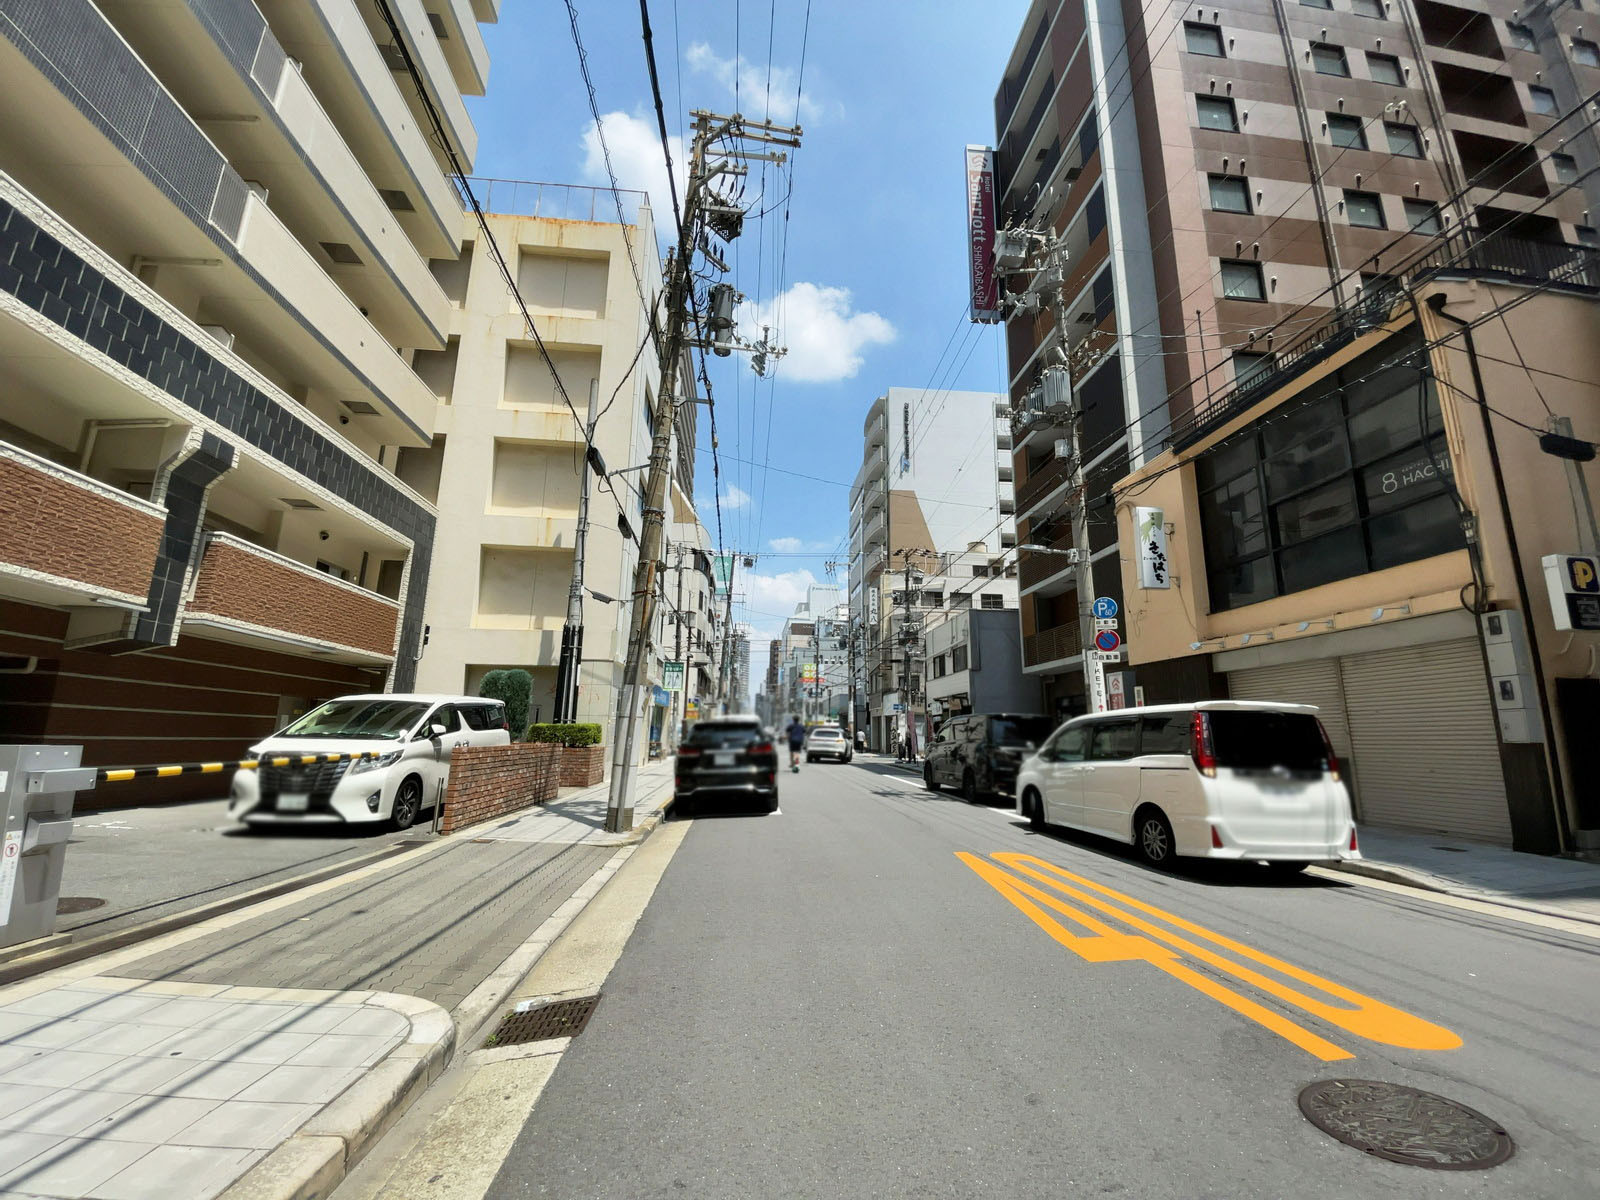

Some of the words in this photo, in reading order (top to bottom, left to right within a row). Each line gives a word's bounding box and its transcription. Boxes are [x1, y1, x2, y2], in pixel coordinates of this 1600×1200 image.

[984, 176, 992, 193] Hotel
[970, 175, 987, 243] Sanrriott
[973, 245, 985, 305] SHINSAIBASHI
[1382, 472, 1398, 494] 8
[1098, 602, 1107, 616] P
[954, 851, 1464, 1062] 40
